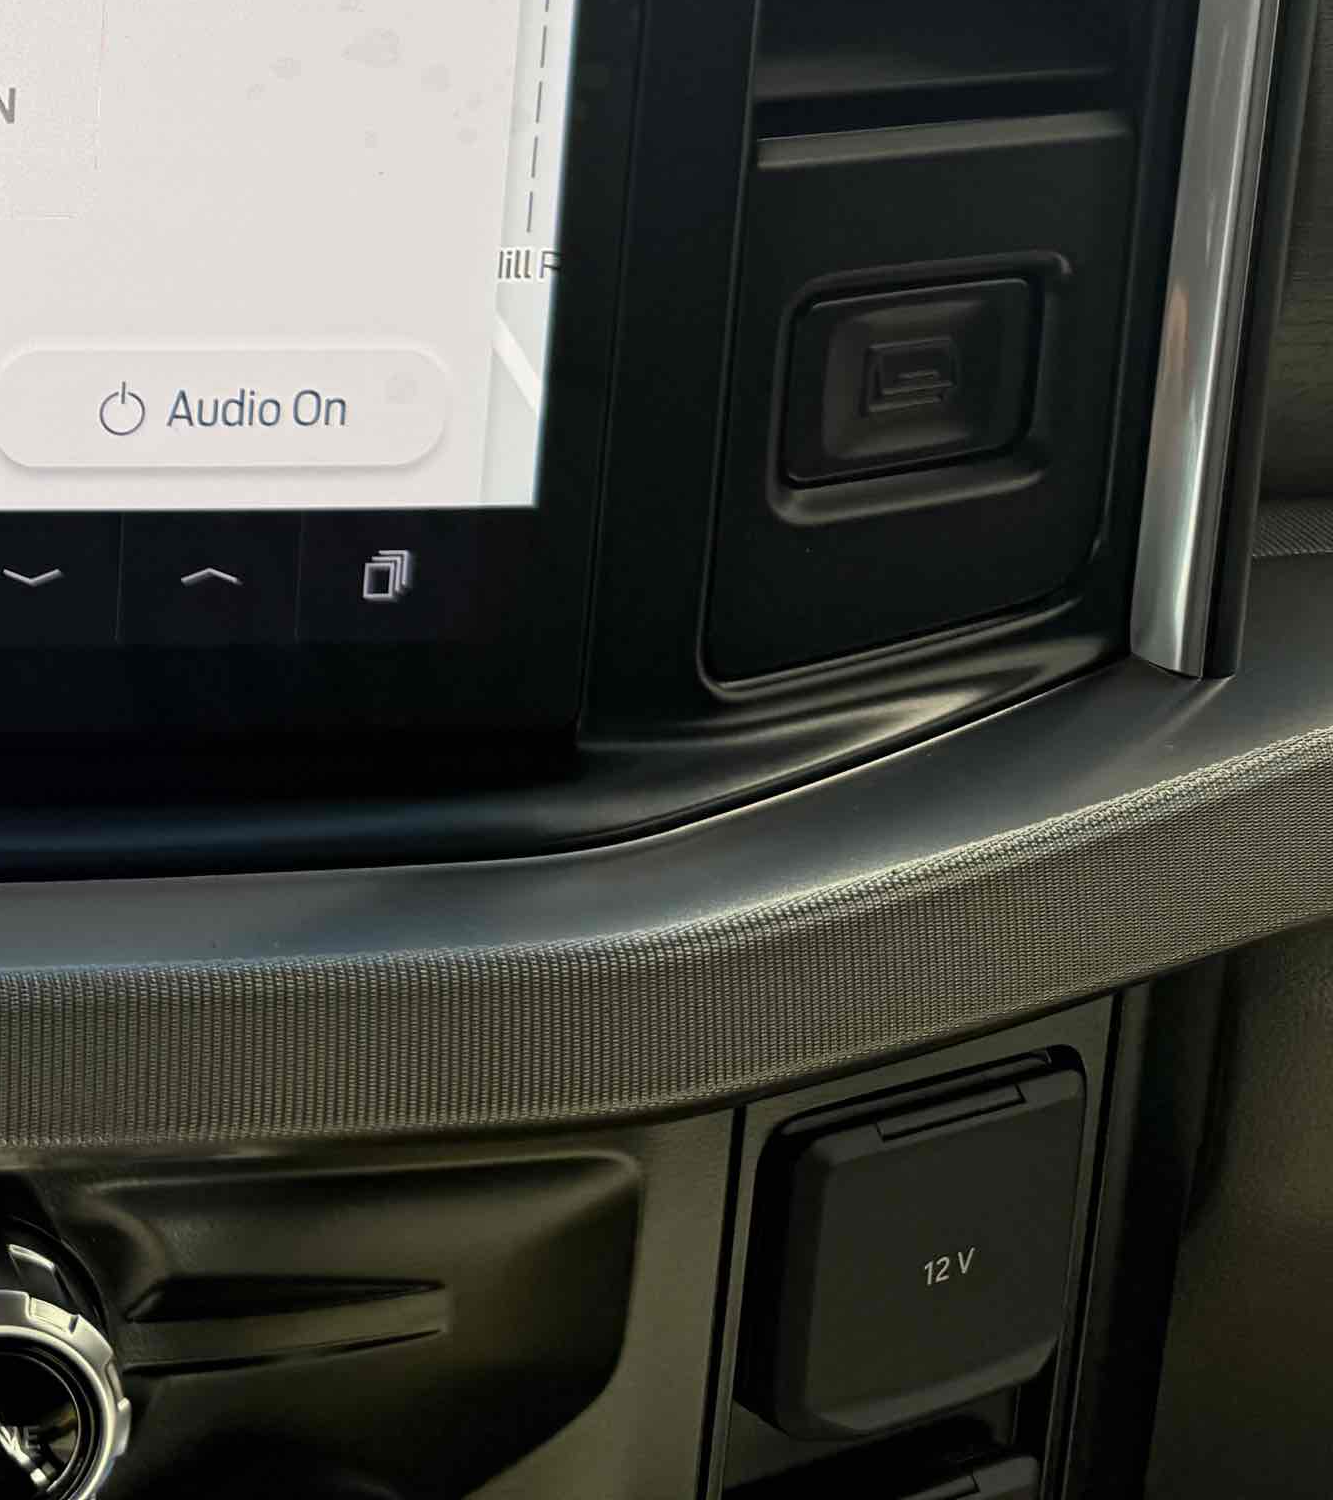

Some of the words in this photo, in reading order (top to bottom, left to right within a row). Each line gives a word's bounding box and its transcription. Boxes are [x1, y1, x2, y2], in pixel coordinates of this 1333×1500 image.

[166, 388, 282, 429] Audio
[293, 389, 348, 427] On
[924, 1256, 951, 1286] 12
[957, 1247, 976, 1274] V
